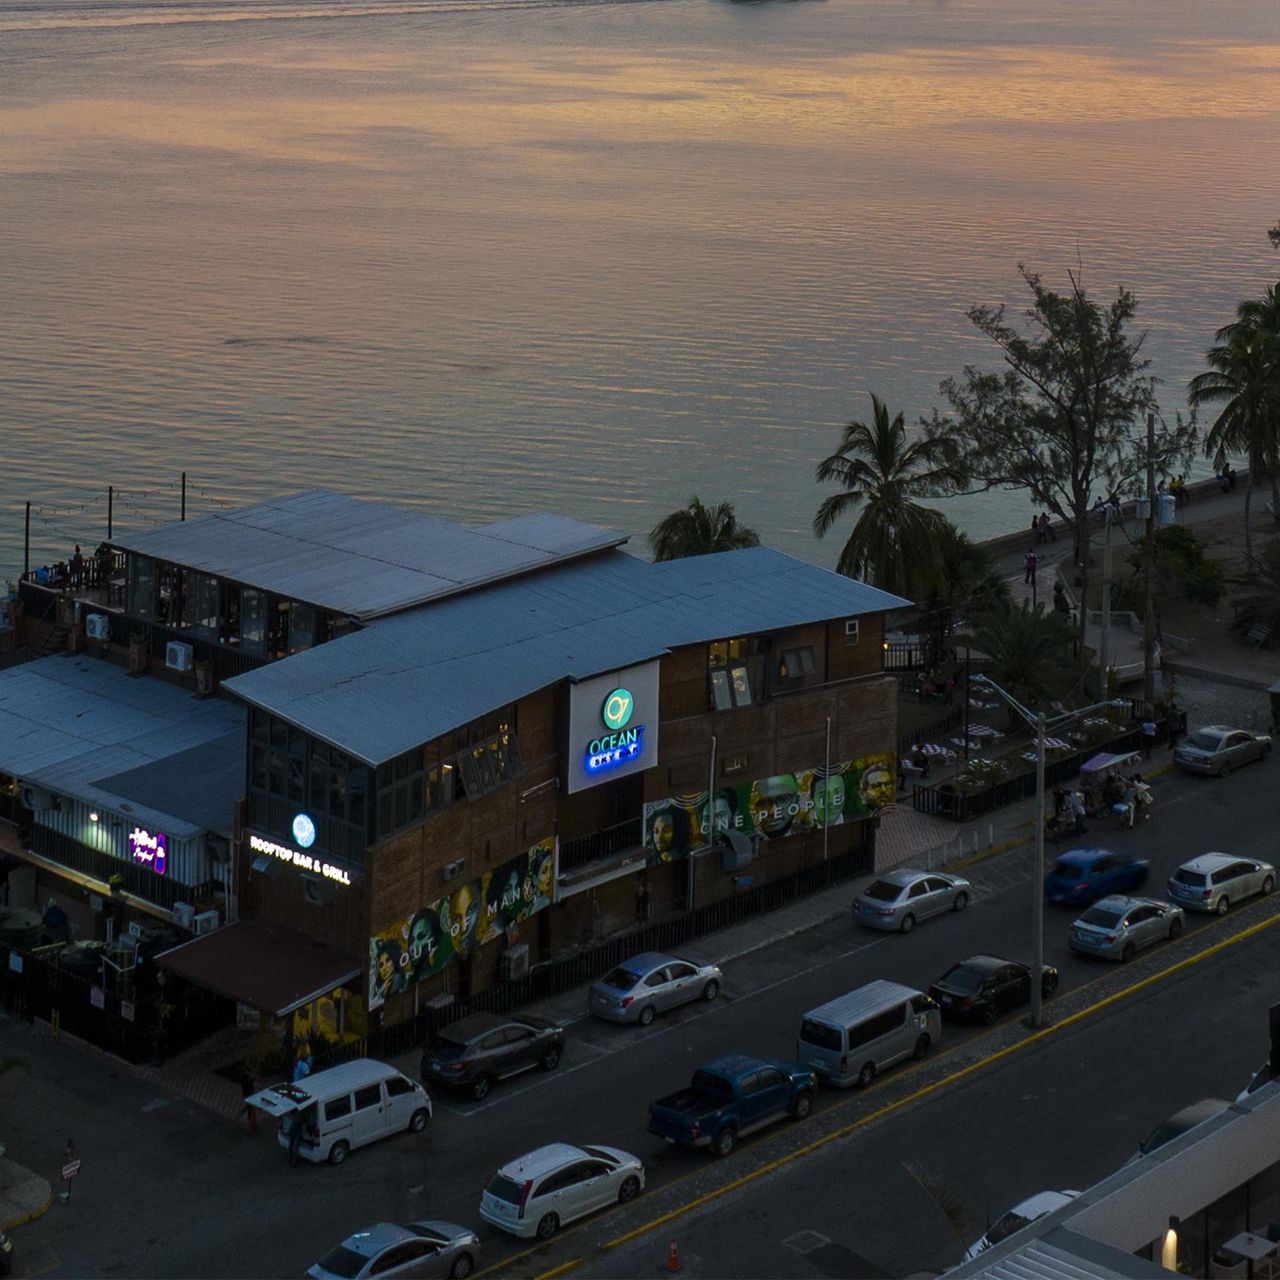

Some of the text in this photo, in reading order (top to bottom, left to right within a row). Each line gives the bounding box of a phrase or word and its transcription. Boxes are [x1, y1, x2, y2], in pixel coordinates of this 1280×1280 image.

[593, 746, 639, 766] SKY BAR
[699, 794, 842, 835] ONE PEOPLE
[250, 835, 351, 885] ROOFTOP BAR & GRILL
[399, 877, 532, 967] OUT OF MANY
